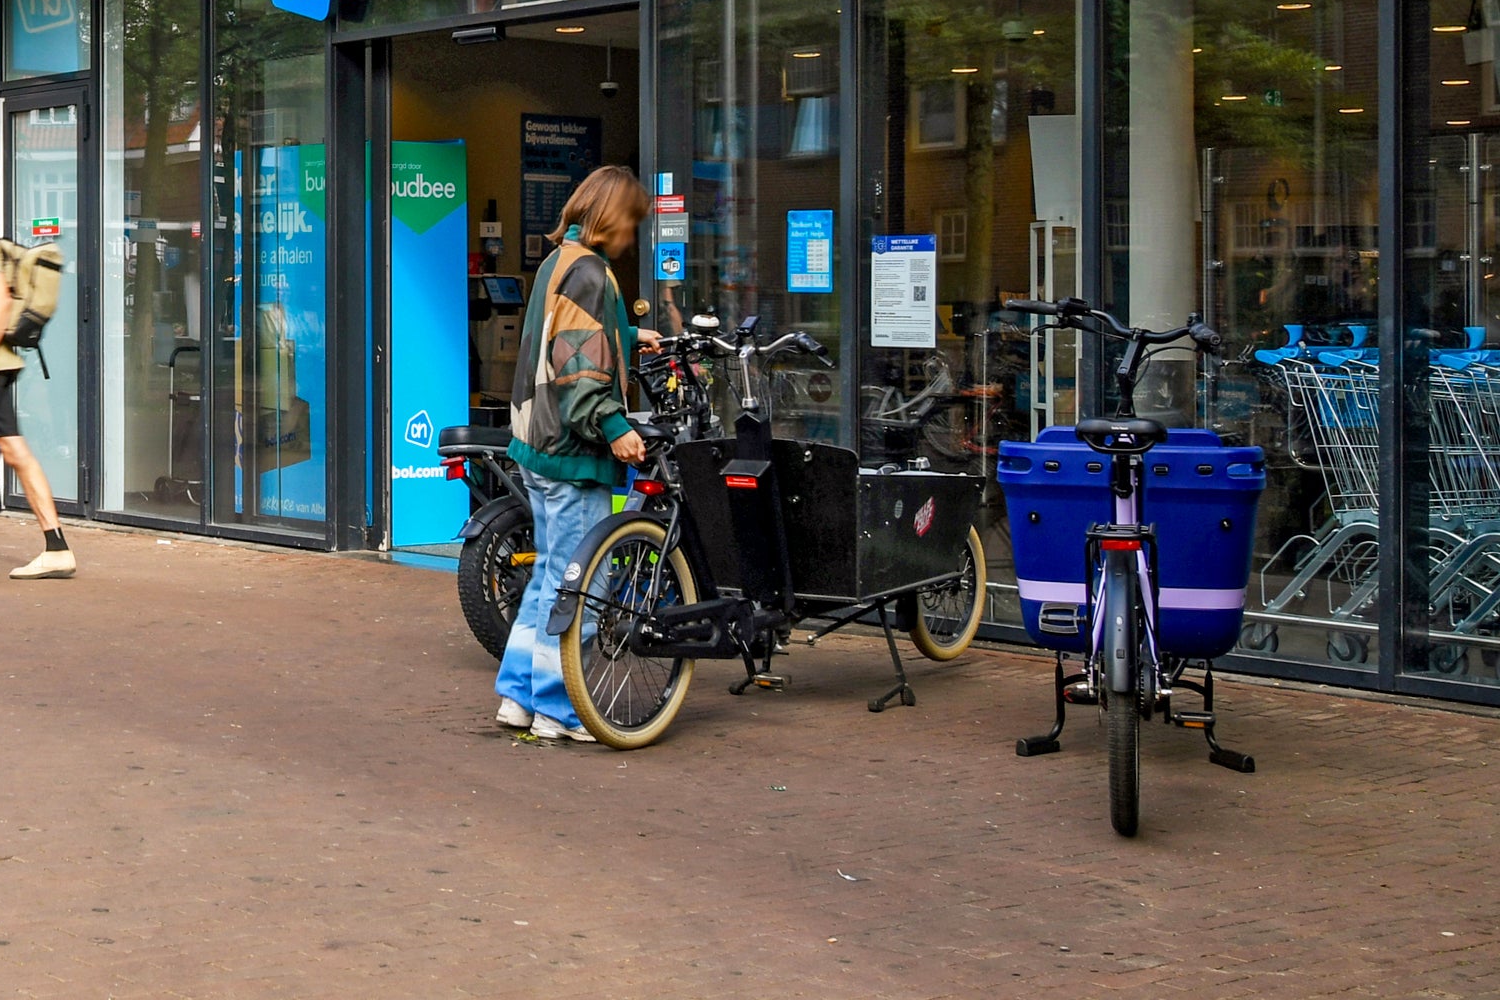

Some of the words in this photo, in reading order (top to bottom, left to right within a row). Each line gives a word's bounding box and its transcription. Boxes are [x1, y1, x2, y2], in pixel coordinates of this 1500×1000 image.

[525, 120, 560, 133] Gewoon
[561, 122, 588, 134] lekker
[525, 132, 579, 146] bijverdienen.
[270, 245, 313, 264] afhalen
[661, 249, 680, 257] Gratis
[392, 465, 444, 479] bol.com
[295, 503, 309, 513] van
[482, 532, 499, 602] KENDA
